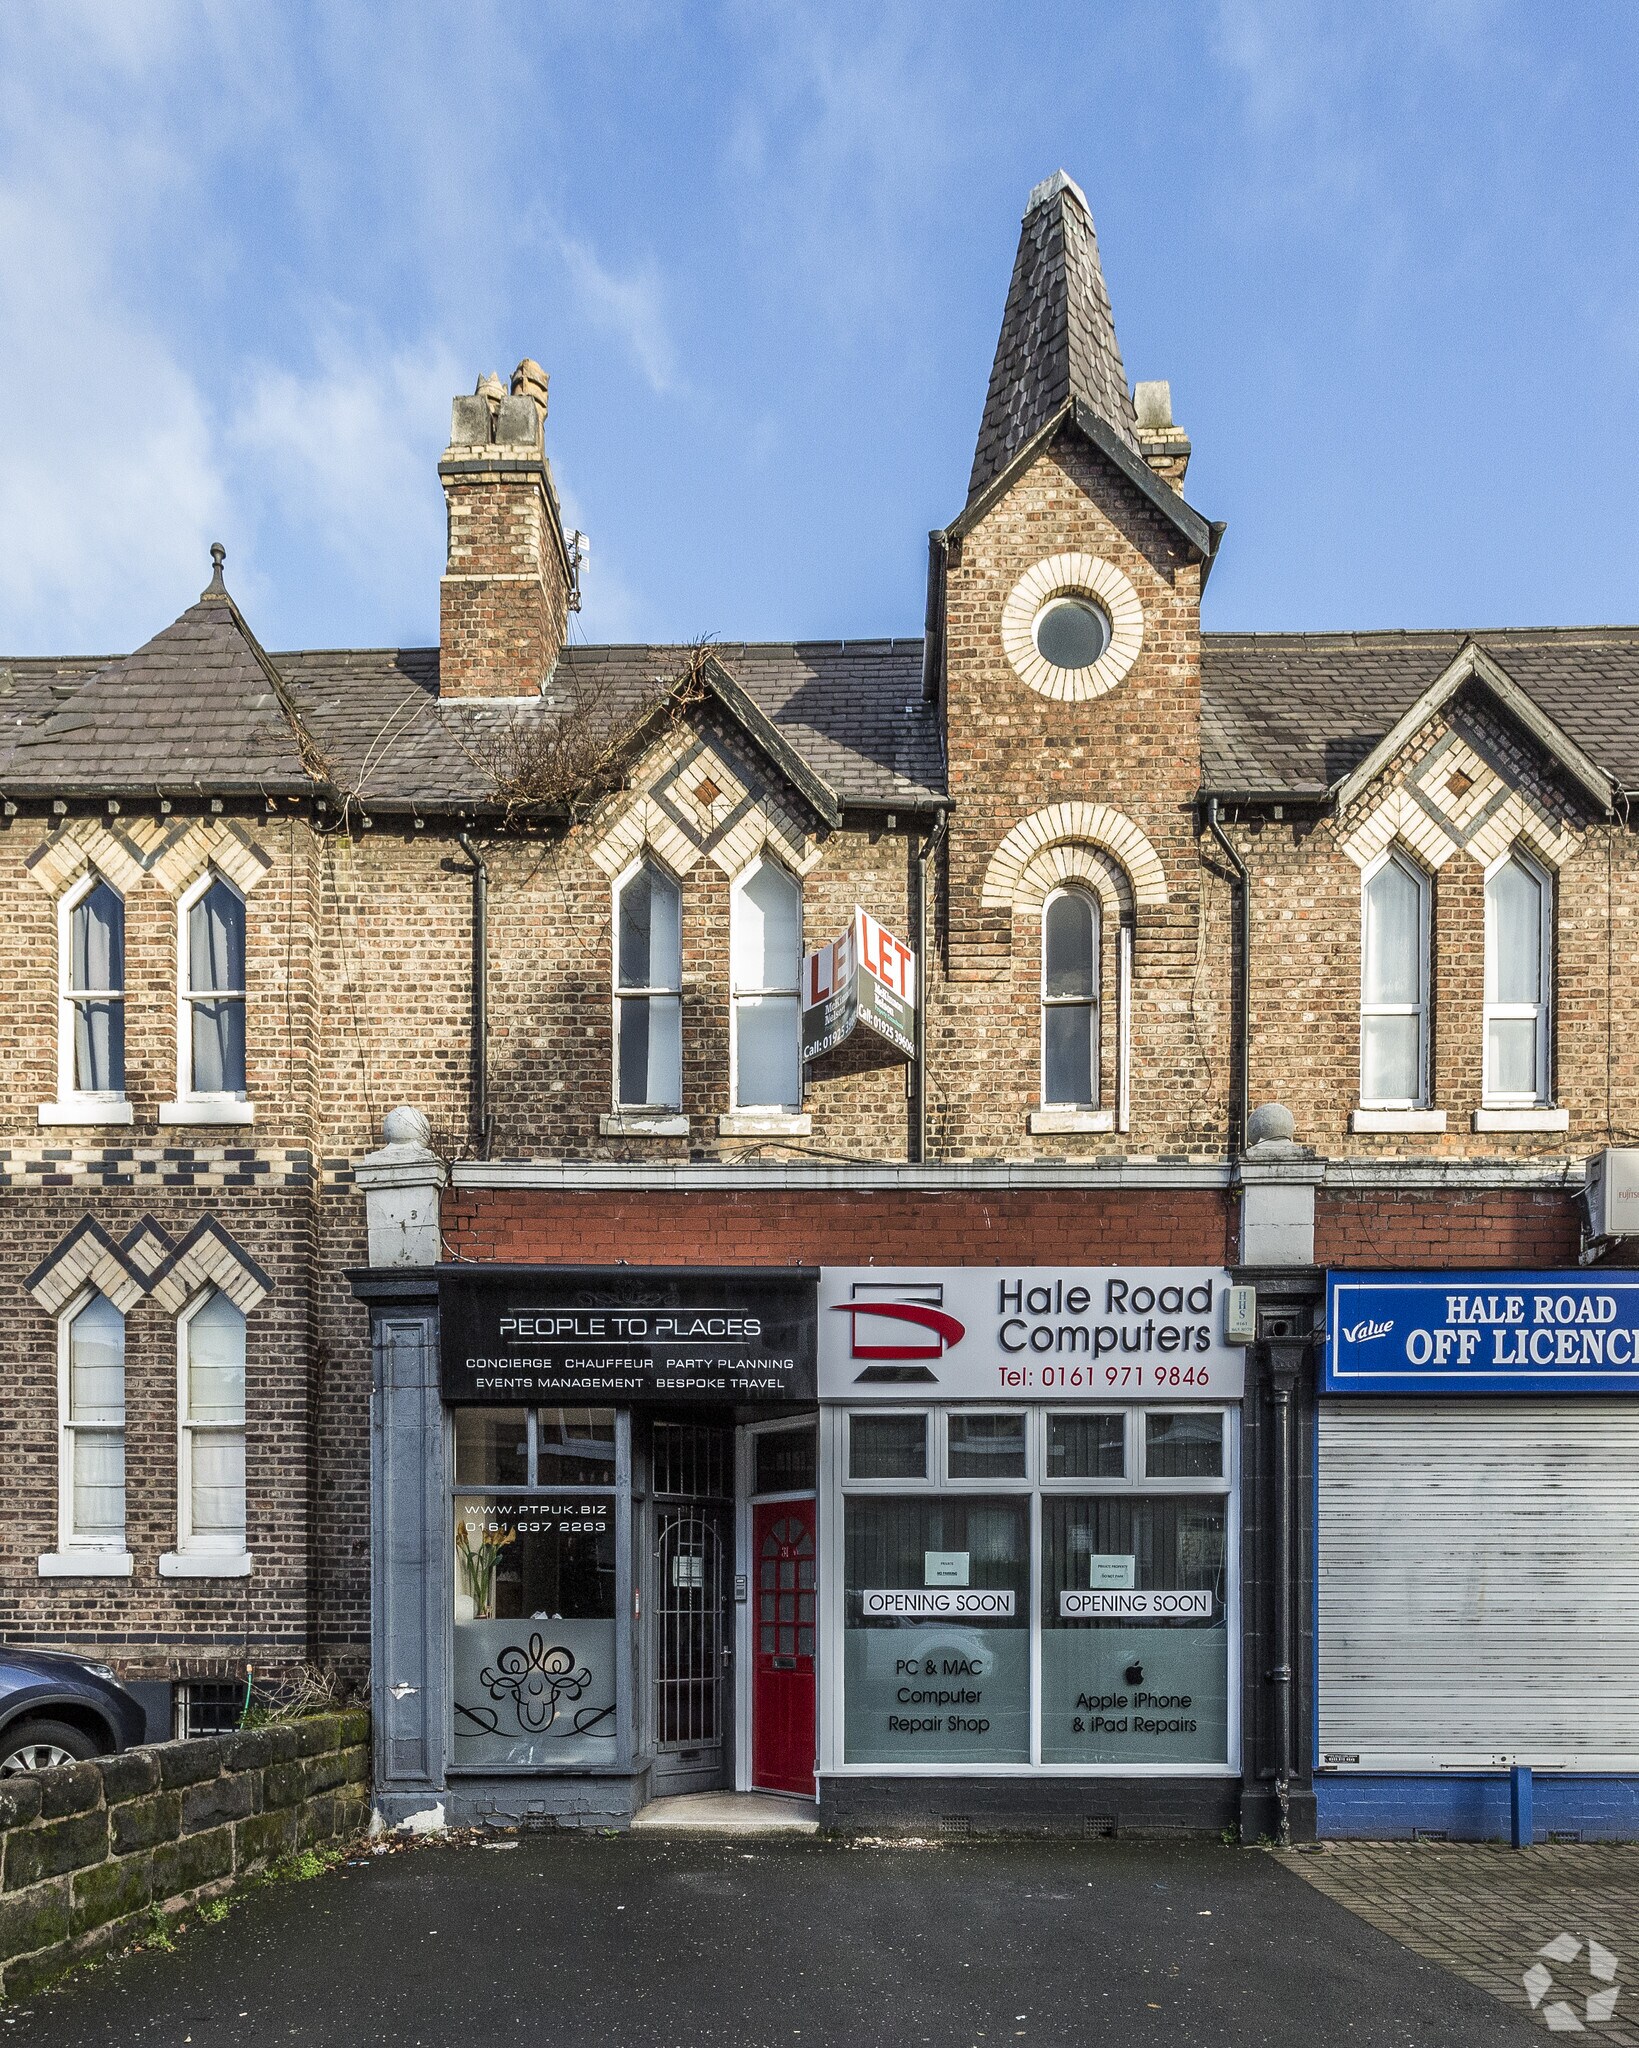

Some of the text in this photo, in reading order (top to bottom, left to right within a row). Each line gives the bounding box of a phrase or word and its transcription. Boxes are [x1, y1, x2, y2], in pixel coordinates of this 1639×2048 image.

[862, 913, 911, 998] LET
[858, 1003, 873, 1025] Call:
[873, 1015, 894, 1040] 01925
[803, 1040, 822, 1058] Call:
[823, 1024, 845, 1049] 01925
[999, 1279, 1212, 1315] Hale Road
[1446, 1295, 1617, 1324] HALE ROAD
[500, 1318, 761, 1335] PEOPLE TO PLACES
[1342, 1320, 1394, 1343] Value
[1000, 1319, 1211, 1358] Computers
[1405, 1329, 1481, 1365] OFF
[466, 1358, 794, 1369] CONCIERGE CHAUFFEUR PARTY PLANNING
[476, 1378, 785, 1388] EVENTS MANAGEMENT BESPOKE TRAVEL
[999, 1367, 1209, 1386] Tel: 0161 971 9846
[464, 1505, 607, 1514] WWW.PTPUK.BIZ
[465, 1522, 606, 1532] 0161 637 2263
[868, 1594, 1010, 1612] OPENING SOON
[1065, 1595, 1207, 1613] OPENING SOON
[896, 1659, 983, 1675] PC & MAC
[897, 1687, 982, 1707] Computer
[1076, 1692, 1192, 1710] Apple iPhone
[888, 1715, 990, 1736] Repair Shop
[1073, 1715, 1197, 1735] & iPad Repairs
